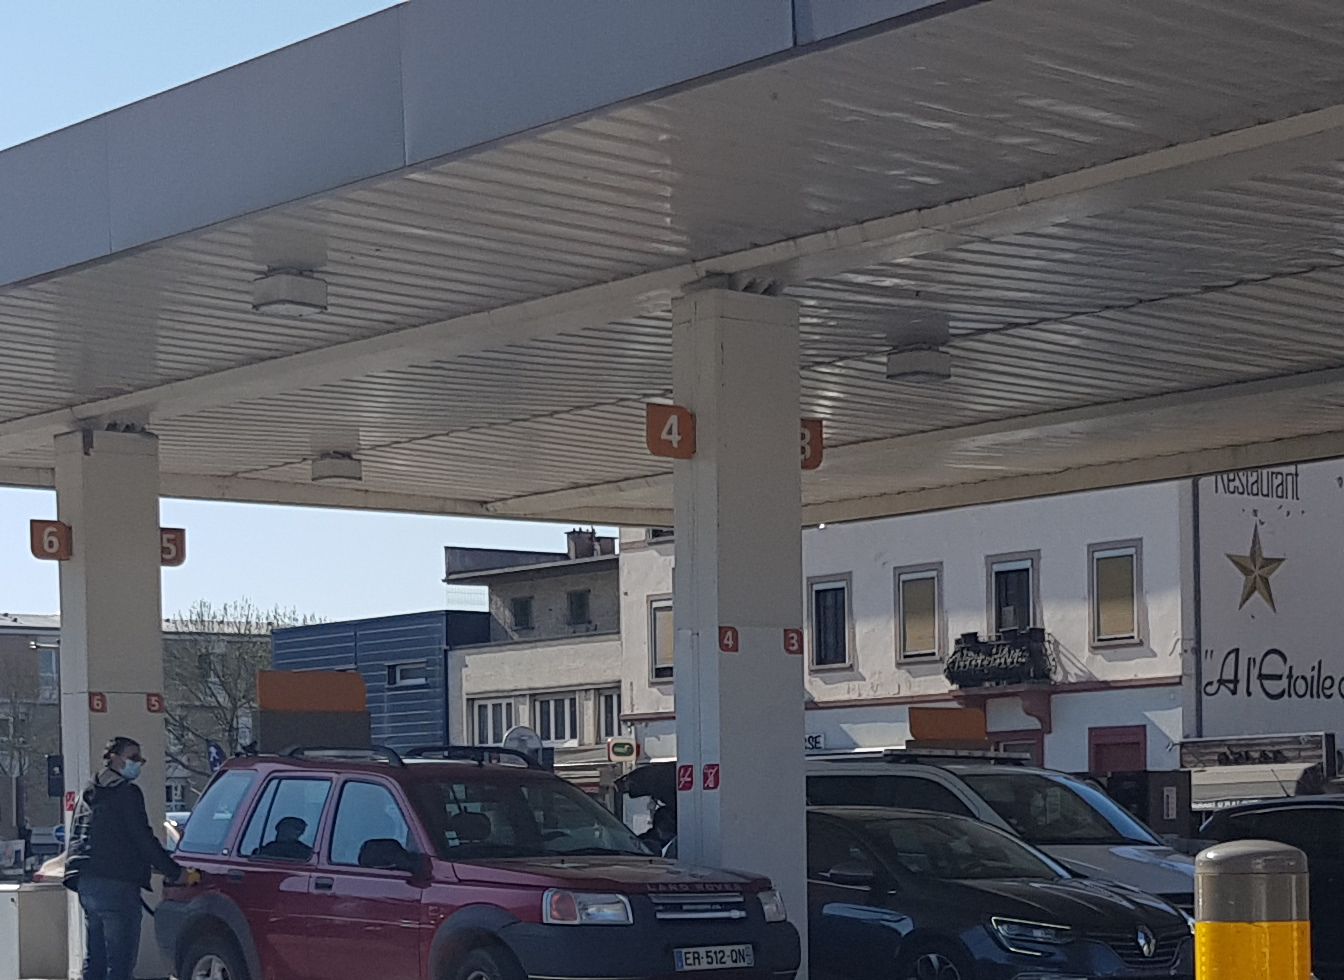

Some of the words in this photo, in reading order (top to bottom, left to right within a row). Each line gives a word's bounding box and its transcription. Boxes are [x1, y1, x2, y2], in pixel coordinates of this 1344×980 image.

[660, 404, 682, 449] 4
[43, 526, 60, 553] 6
[162, 533, 177, 560] 5
[723, 630, 734, 649] 4
[788, 632, 799, 651] 3
[94, 695, 103, 711] 6
[150, 695, 160, 711] 5
[683, 948, 747, 967] ER-512-QN
